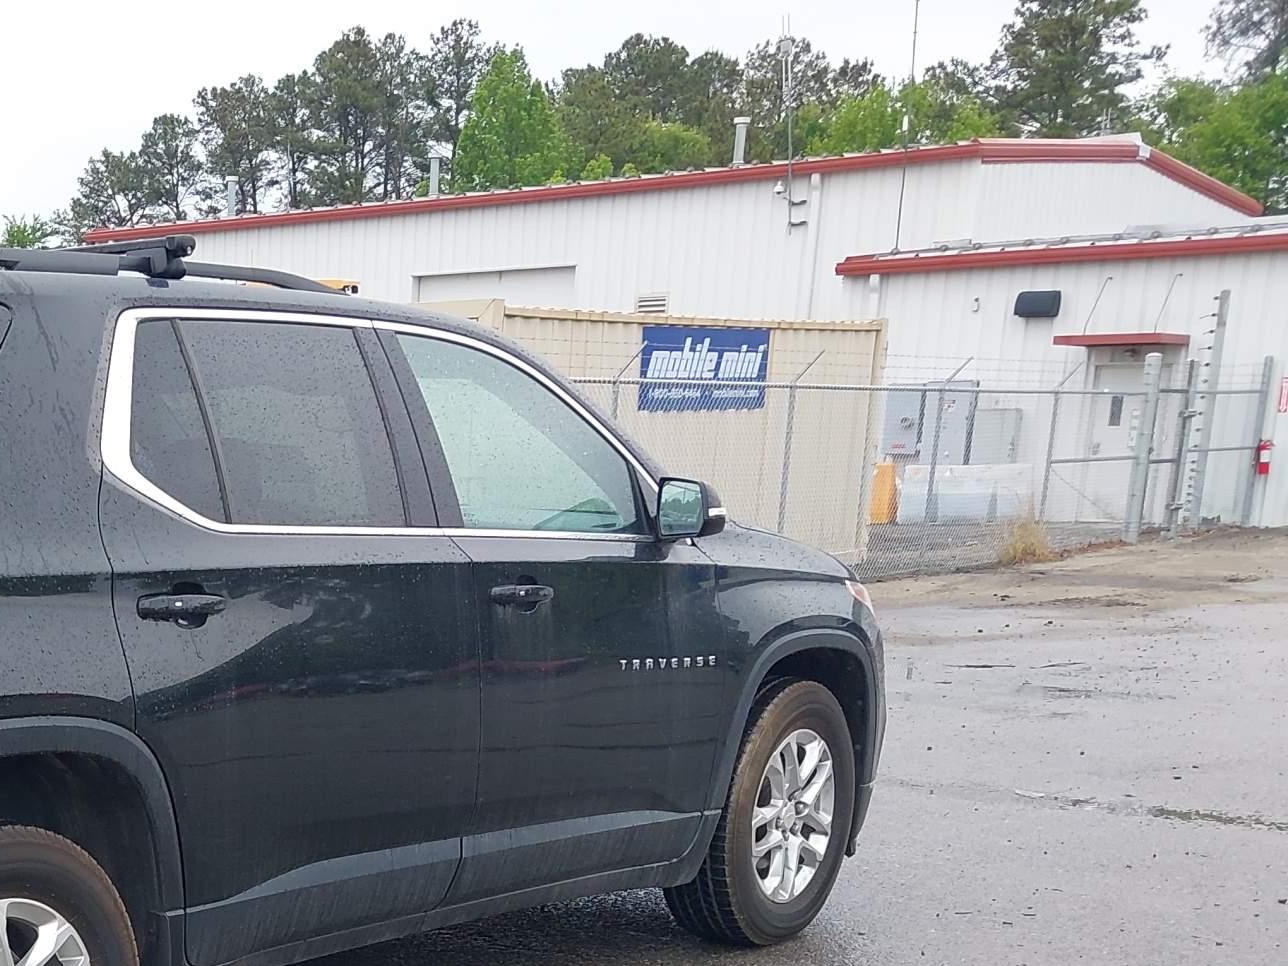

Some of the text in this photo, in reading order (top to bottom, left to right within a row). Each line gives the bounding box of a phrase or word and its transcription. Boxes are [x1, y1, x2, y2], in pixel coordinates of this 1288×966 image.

[646, 337, 765, 378] mobile mini
[619, 655, 717, 671] TRAVERSE
